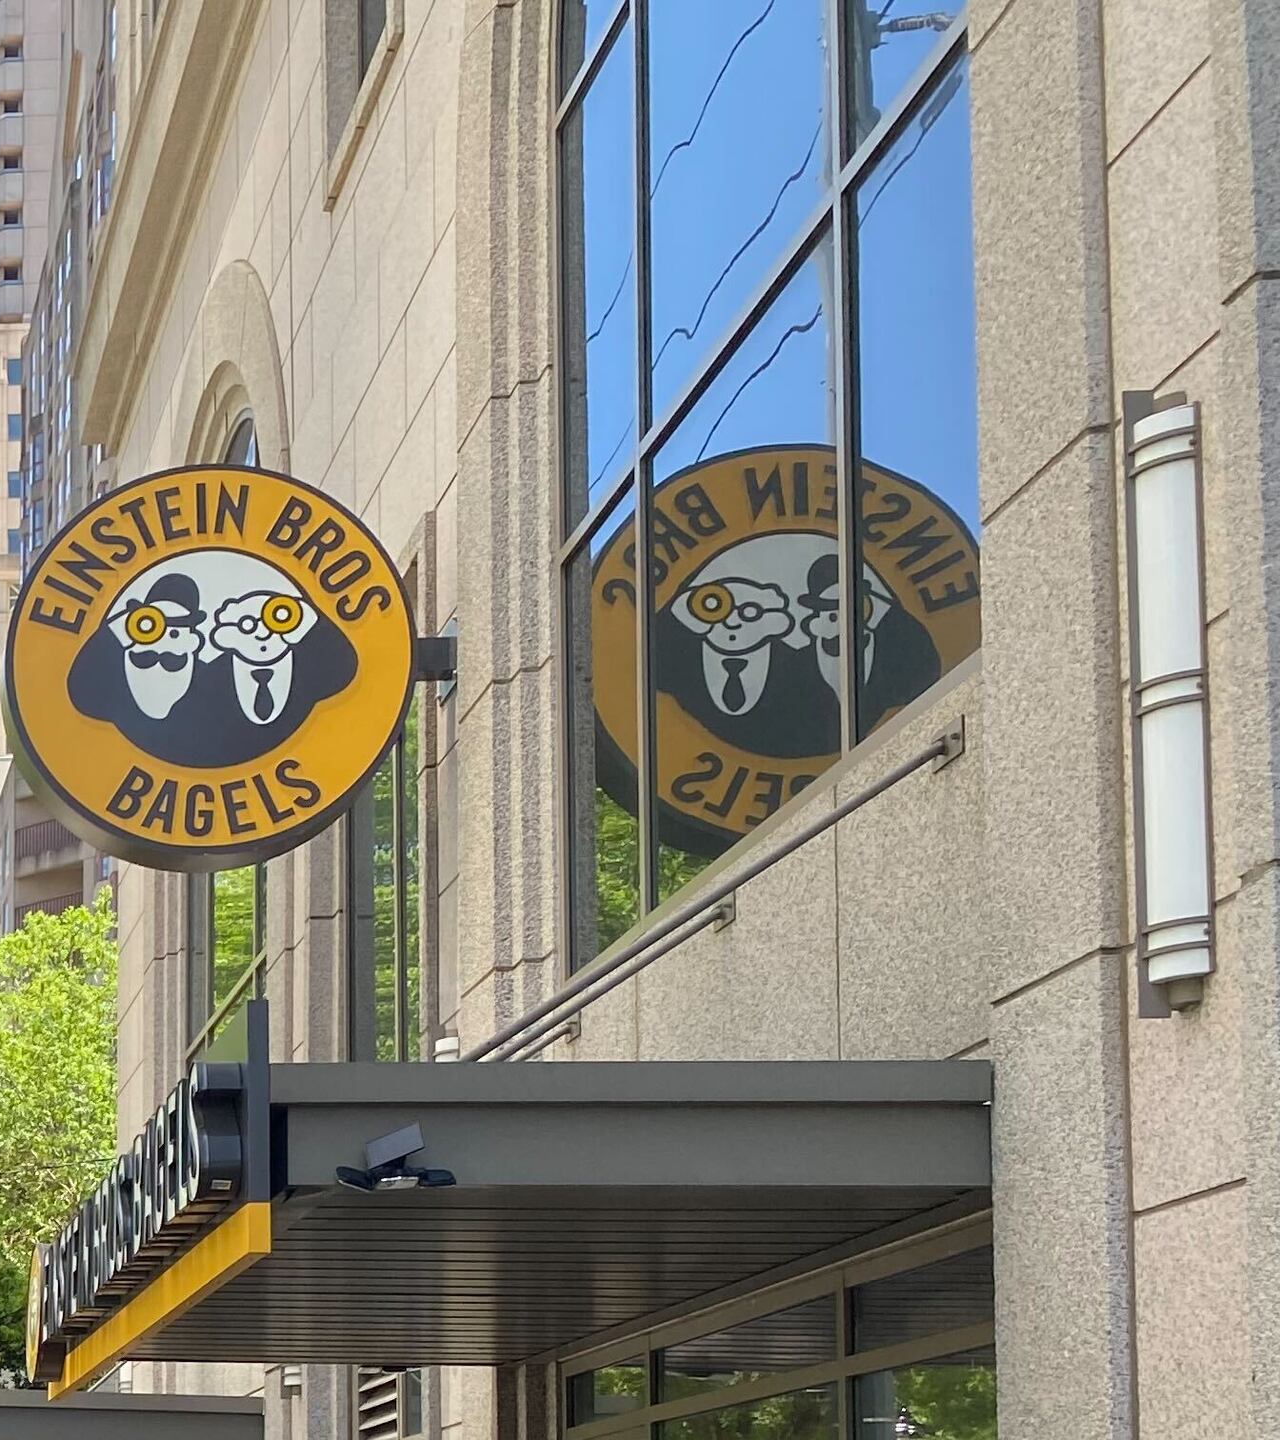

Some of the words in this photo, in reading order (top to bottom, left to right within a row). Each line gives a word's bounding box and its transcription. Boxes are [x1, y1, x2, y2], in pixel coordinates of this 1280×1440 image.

[29, 481, 250, 635] EINSTEIN
[266, 496, 391, 623] BROS
[106, 759, 322, 837] BAGELS
[133, 1062, 202, 1256] BAGELS
